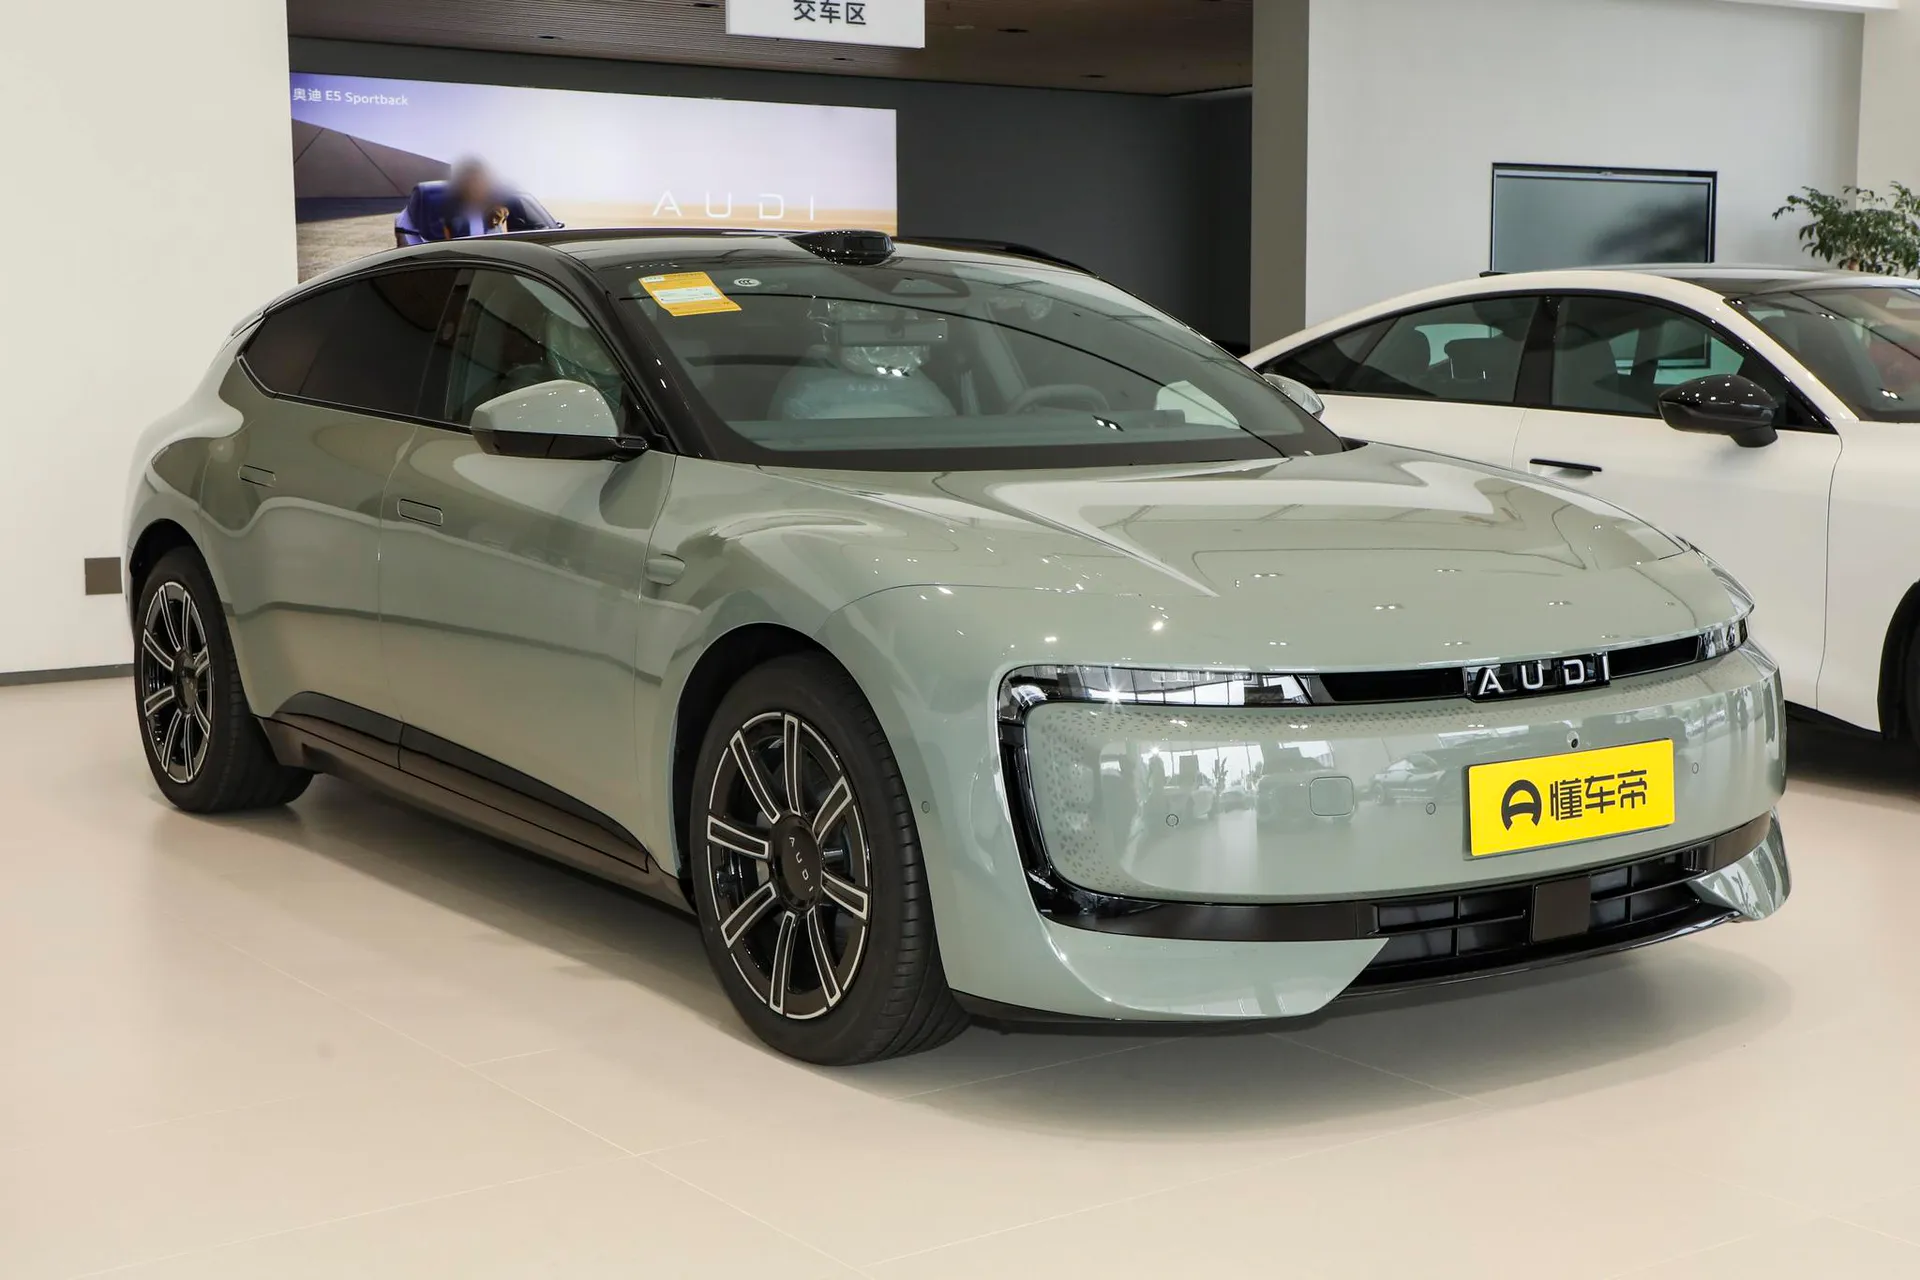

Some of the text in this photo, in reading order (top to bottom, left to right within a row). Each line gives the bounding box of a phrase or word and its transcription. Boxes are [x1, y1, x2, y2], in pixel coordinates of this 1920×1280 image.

[793, 0, 867, 26] 交车区
[293, 88, 409, 106] 奥迪 E5 Sportback
[652, 189, 815, 222] AUDI
[1477, 654, 1611, 696] AUDI
[1549, 769, 1648, 821] 懂车帝
[788, 836, 814, 892] AUDI
